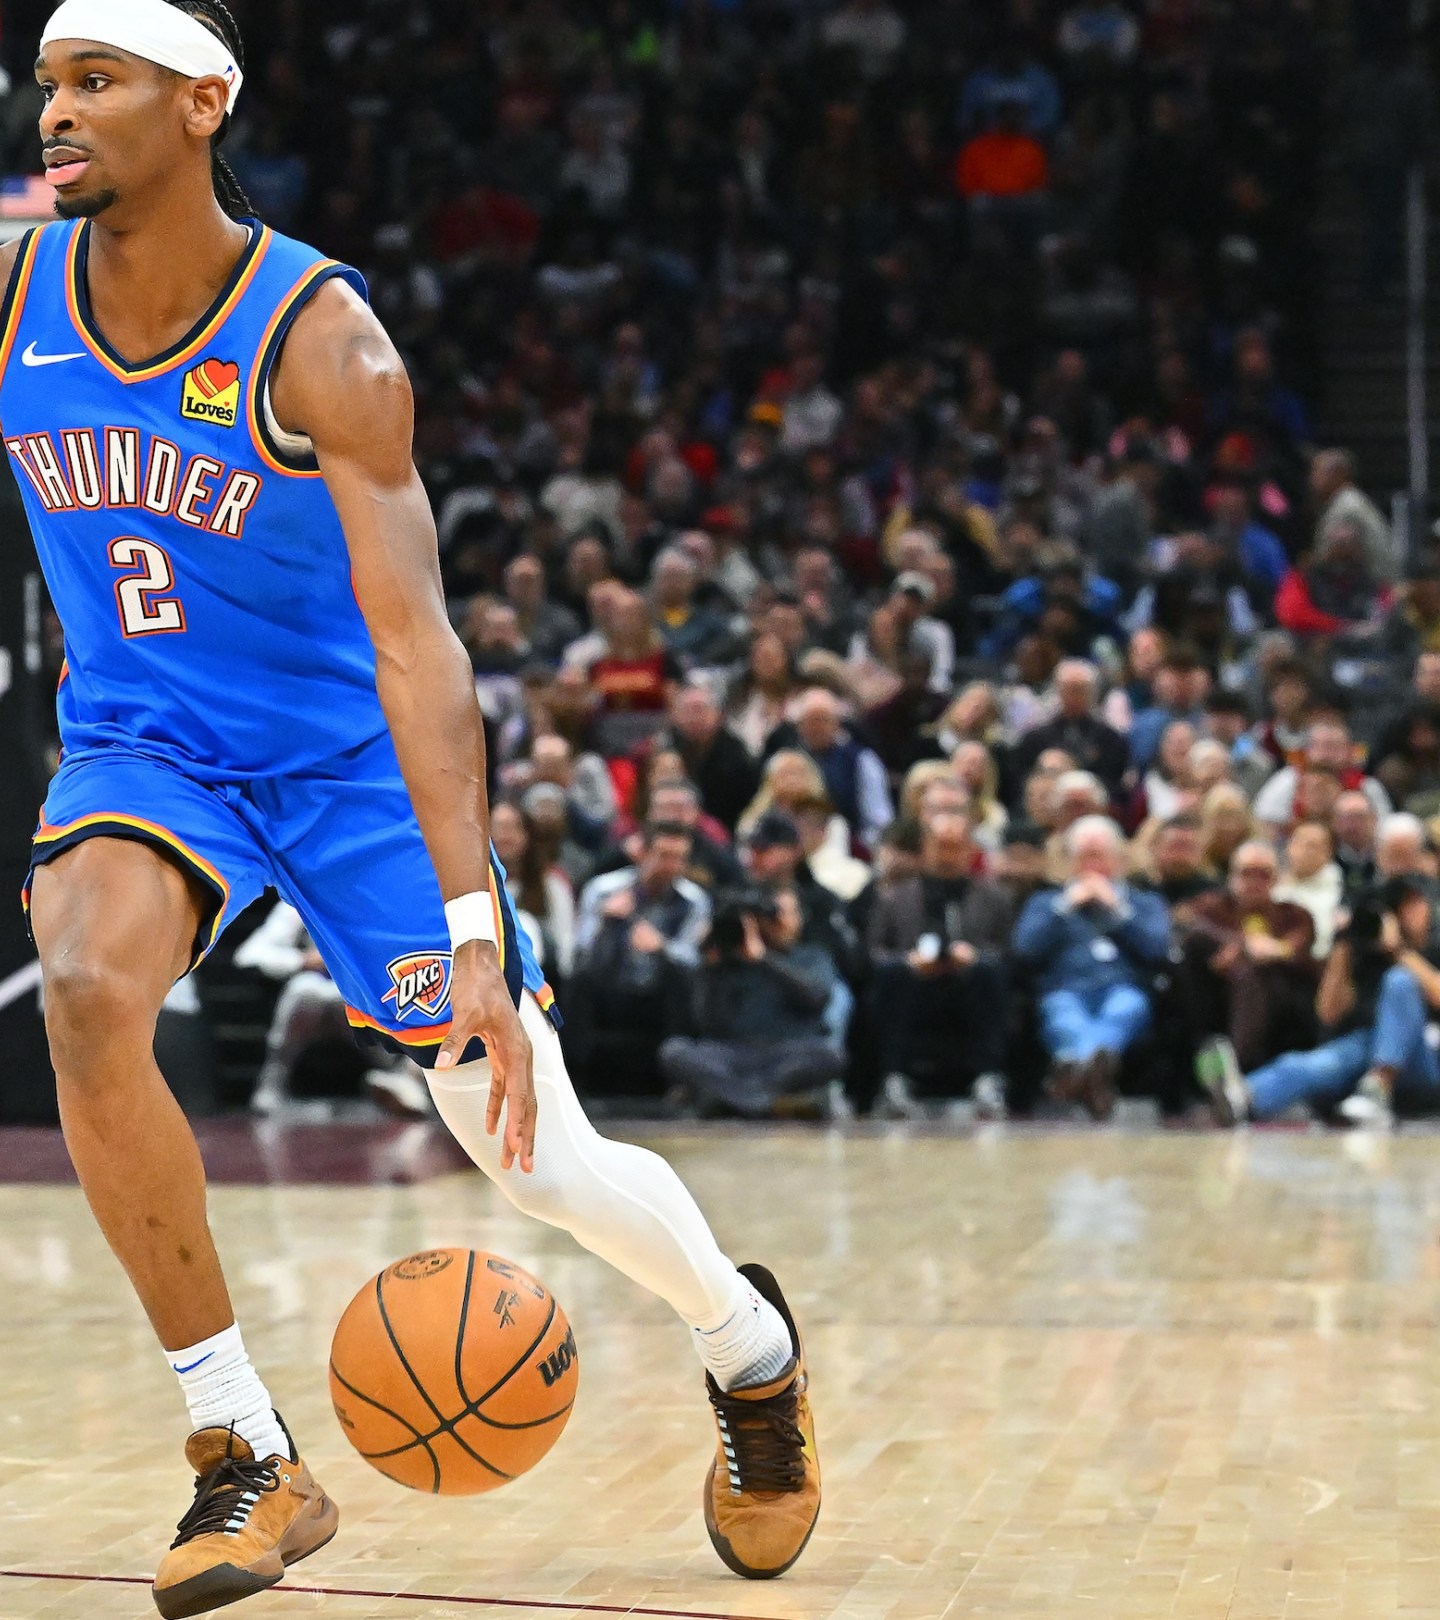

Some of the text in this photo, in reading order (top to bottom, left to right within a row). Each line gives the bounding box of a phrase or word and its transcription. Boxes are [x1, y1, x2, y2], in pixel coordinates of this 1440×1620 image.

[3, 425, 263, 540] THUNDER
[107, 535, 188, 640] 2
[398, 960, 441, 1010] OKC
